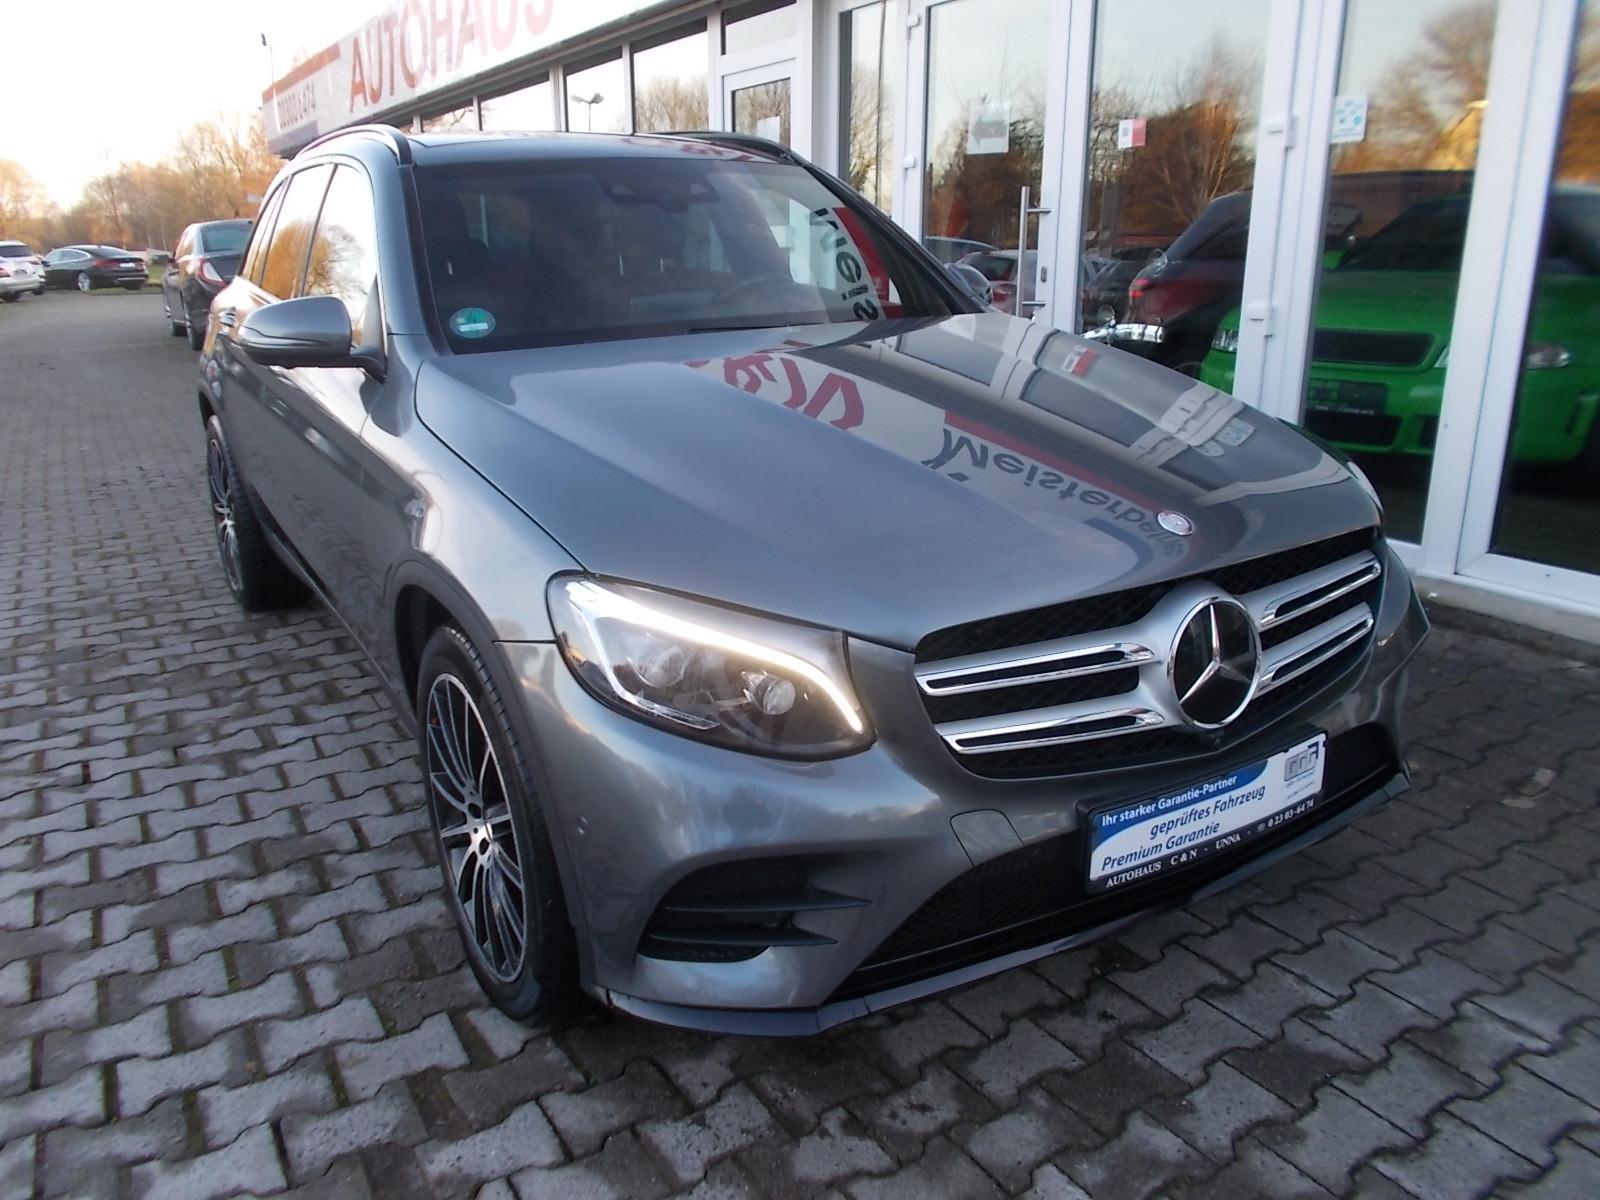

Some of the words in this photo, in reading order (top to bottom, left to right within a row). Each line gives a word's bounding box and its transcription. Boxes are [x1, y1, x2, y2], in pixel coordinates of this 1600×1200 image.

[349, 0, 555, 113] AUTOHA
[1102, 812, 1119, 827] Ihr
[1119, 803, 1157, 822] starker
[1158, 775, 1239, 810] Garantie-Partner
[1150, 806, 1211, 841] geprüftes
[1213, 785, 1267, 815] Fahrzeug
[1101, 842, 1163, 872] Premium
[1165, 820, 1221, 850] Garantie
[1106, 861, 1163, 889] AUTOHAUS
[1215, 834, 1242, 850] UNNA
